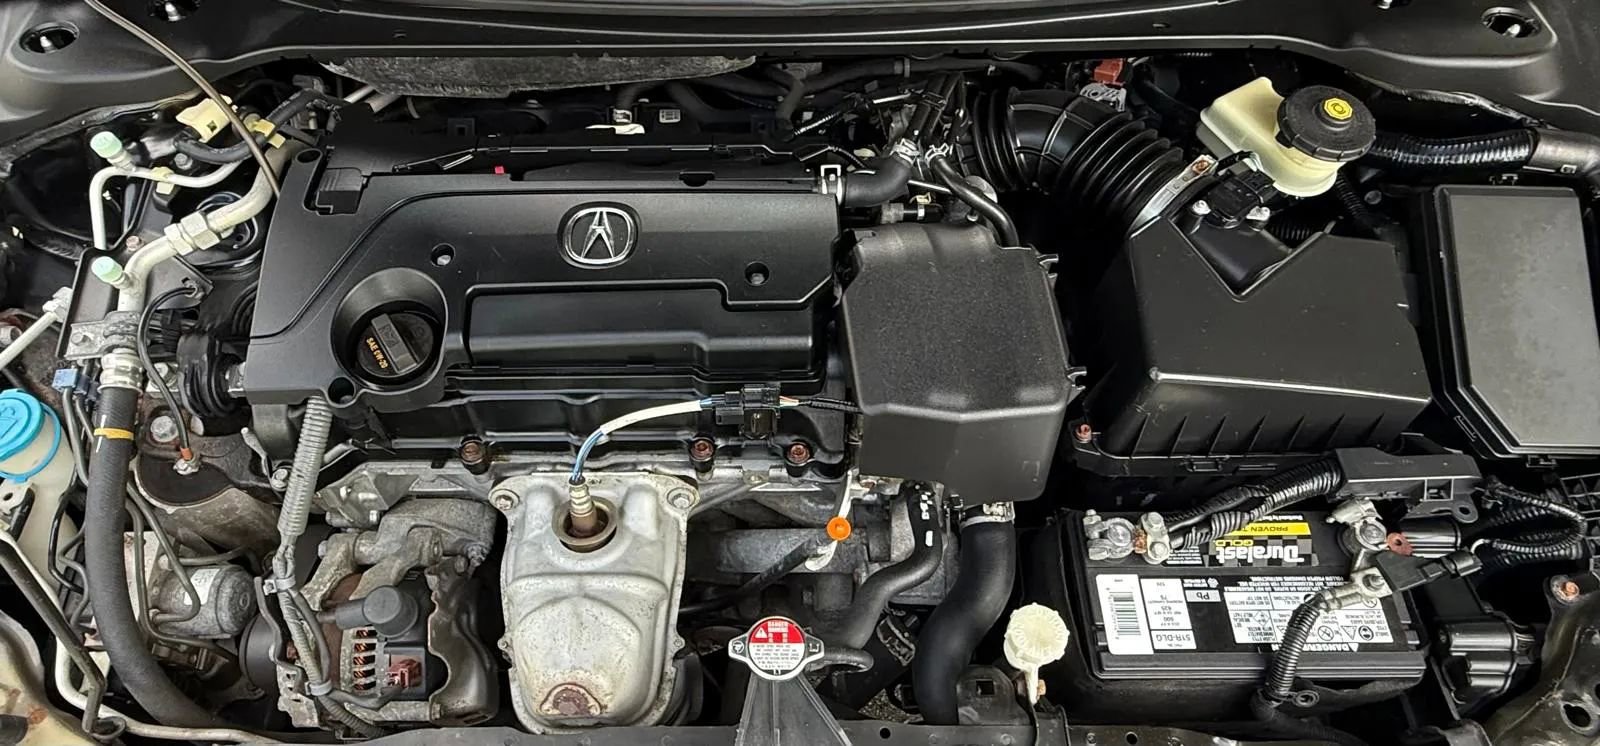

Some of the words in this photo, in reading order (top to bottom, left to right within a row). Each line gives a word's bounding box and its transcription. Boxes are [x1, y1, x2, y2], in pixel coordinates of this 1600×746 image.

[367, 338, 378, 352] SAE
[1216, 545, 1304, 564] Duralast
[1196, 592, 1209, 600] Pb
